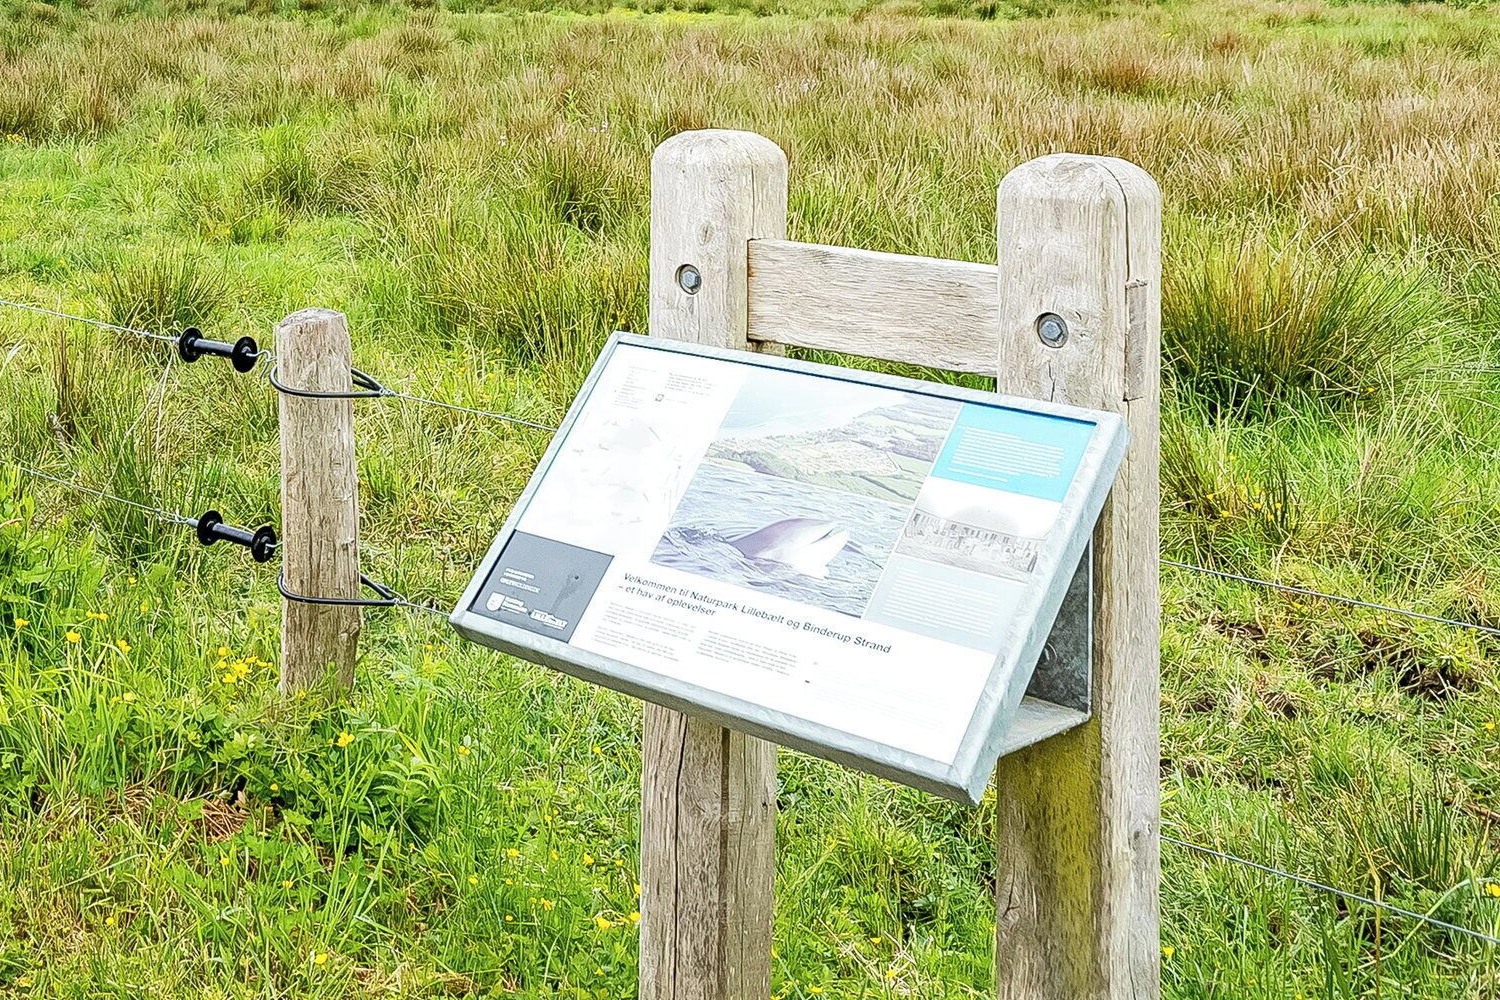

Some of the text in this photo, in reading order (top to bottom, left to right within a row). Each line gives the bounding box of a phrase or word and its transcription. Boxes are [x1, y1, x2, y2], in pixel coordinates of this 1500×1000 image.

[624, 573, 892, 654] Velkommen til Naturpark Lillebælt og Binderup Strand
[625, 585, 636, 594] et
[636, 588, 653, 599] hav
[655, 593, 665, 601] af
[666, 598, 716, 616] oplevelser
